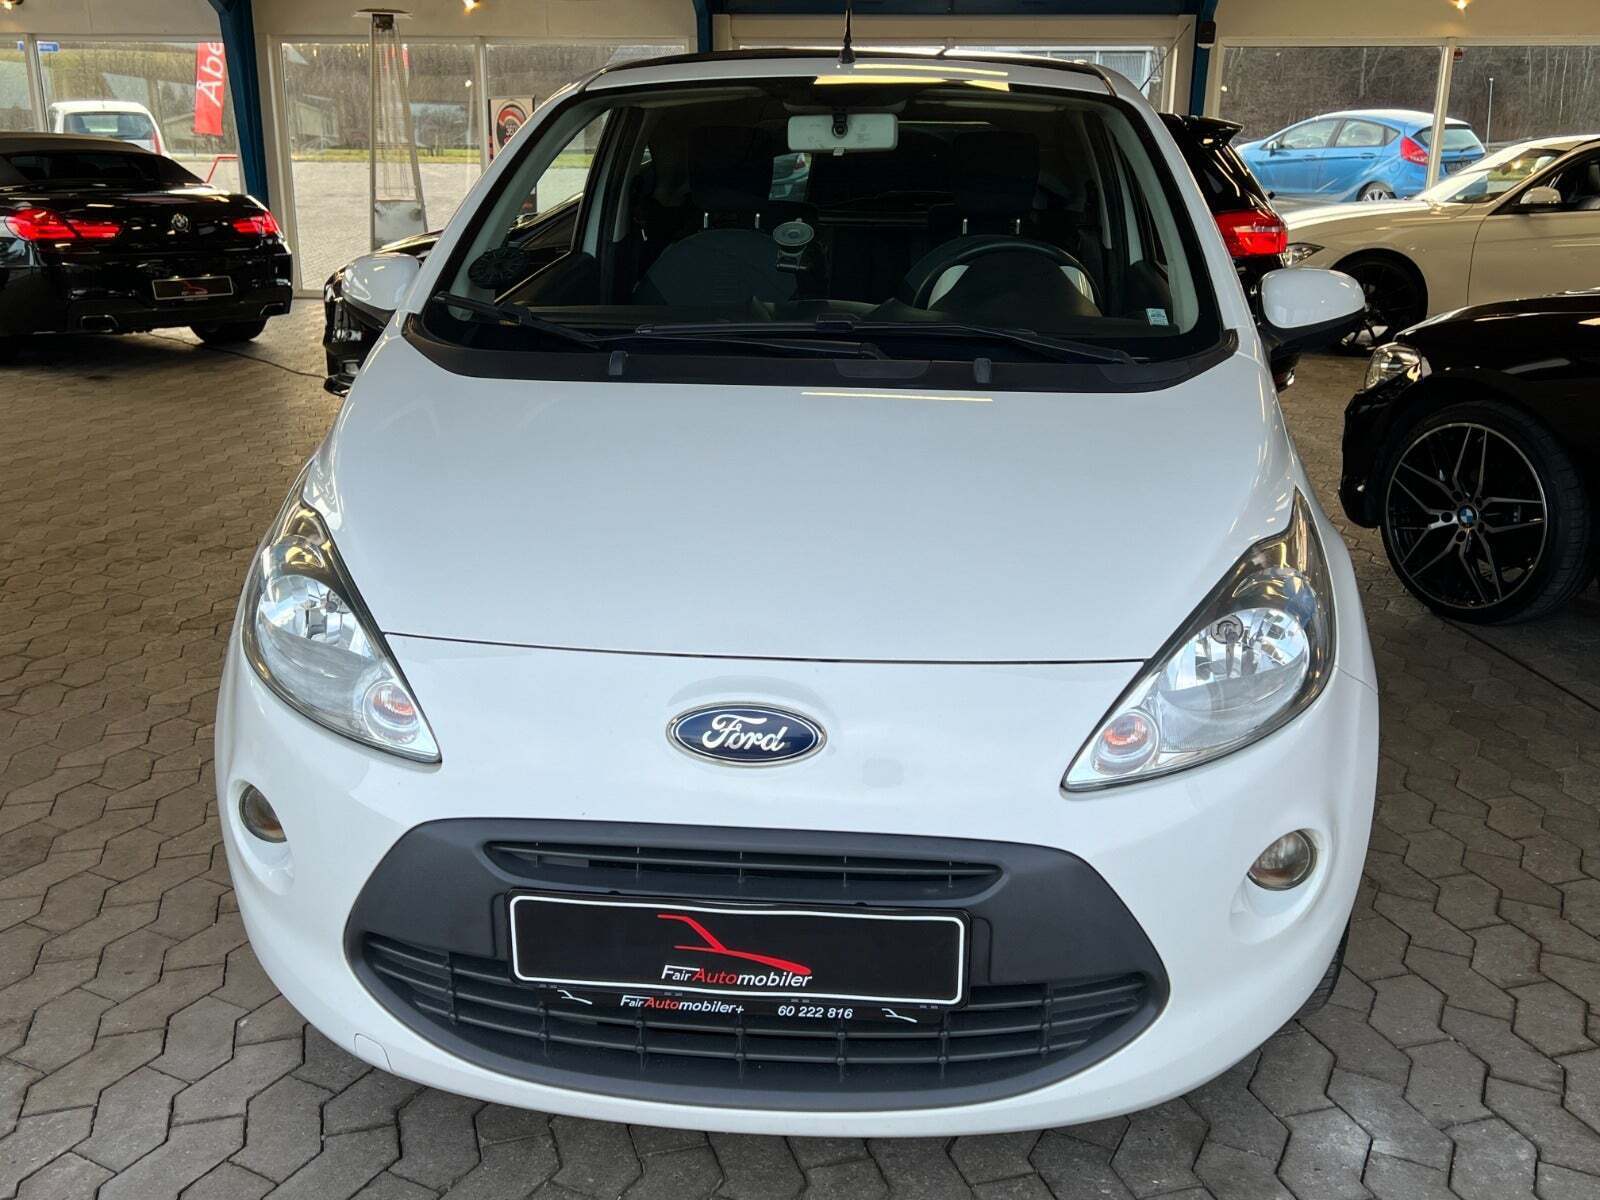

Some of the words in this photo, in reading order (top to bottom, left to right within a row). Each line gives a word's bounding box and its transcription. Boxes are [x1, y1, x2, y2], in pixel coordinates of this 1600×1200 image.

[702, 714, 788, 751] Ford
[777, 1005, 794, 1017] 60
[798, 1006, 823, 1018] 222
[827, 1007, 853, 1019] 816
